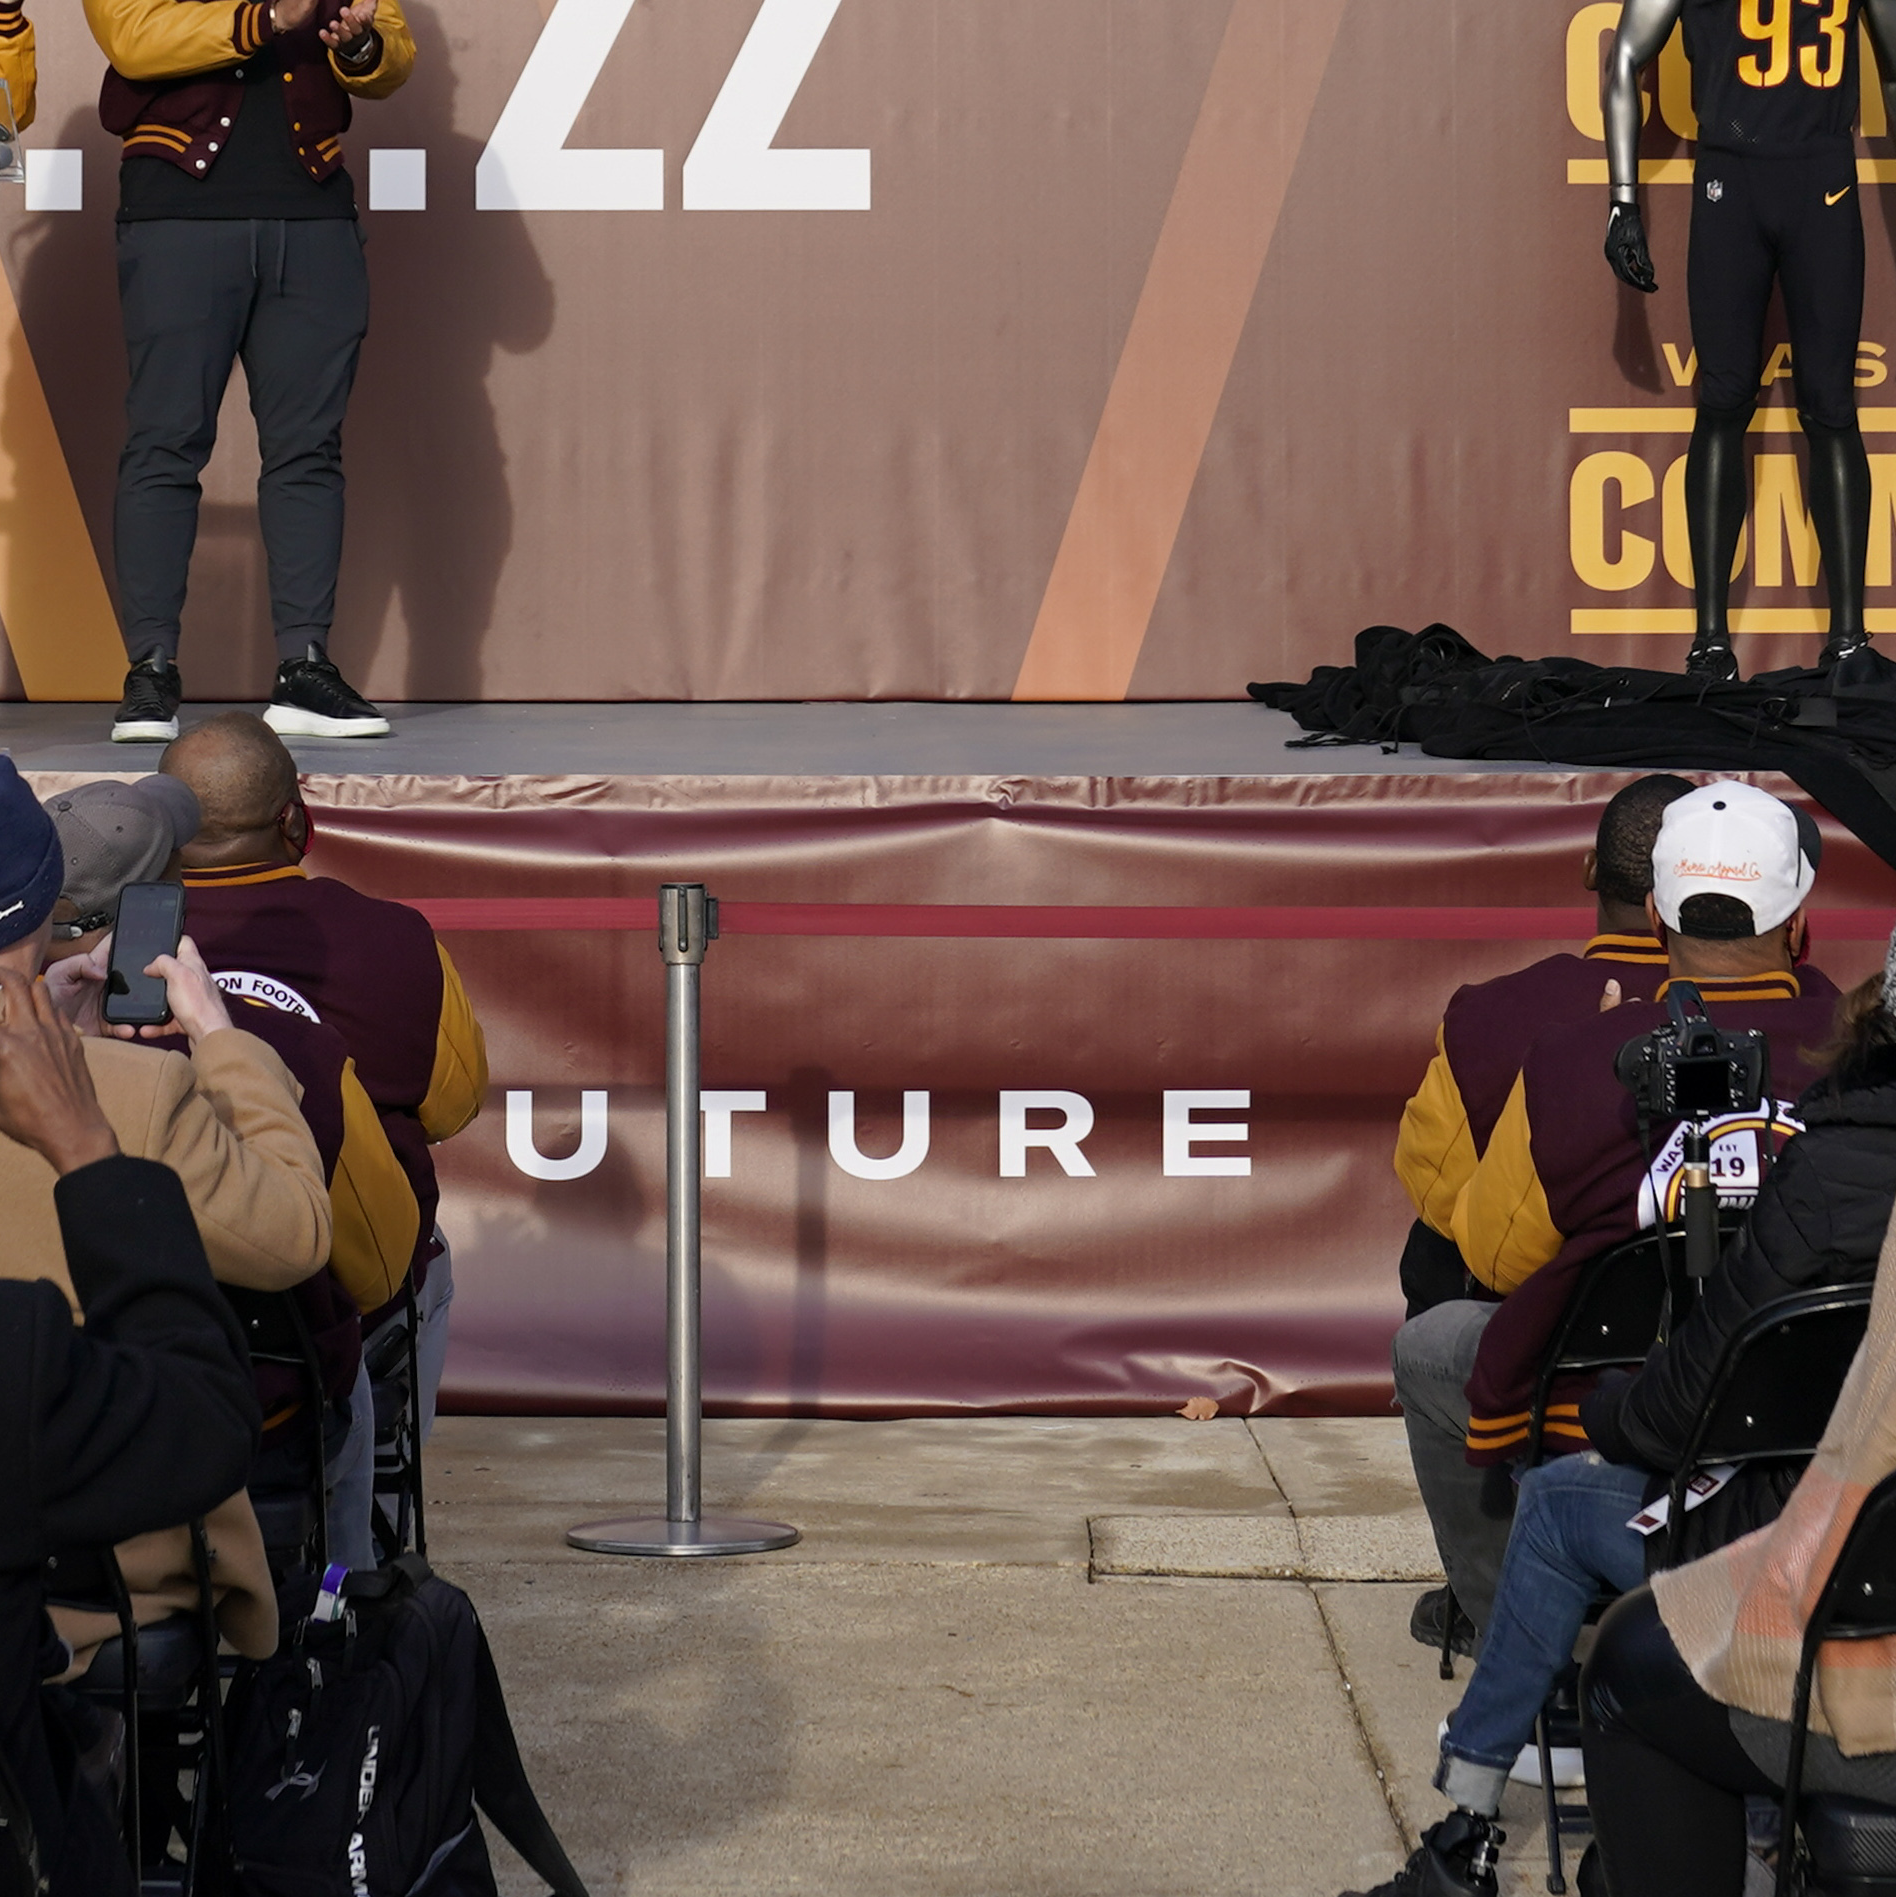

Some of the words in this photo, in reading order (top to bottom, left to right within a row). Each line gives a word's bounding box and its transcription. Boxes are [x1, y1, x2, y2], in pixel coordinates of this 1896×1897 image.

[251, 979, 310, 1019] FOOTB
[504, 1088, 1252, 1181] UTURE
[1711, 1157, 1745, 1177] 19
